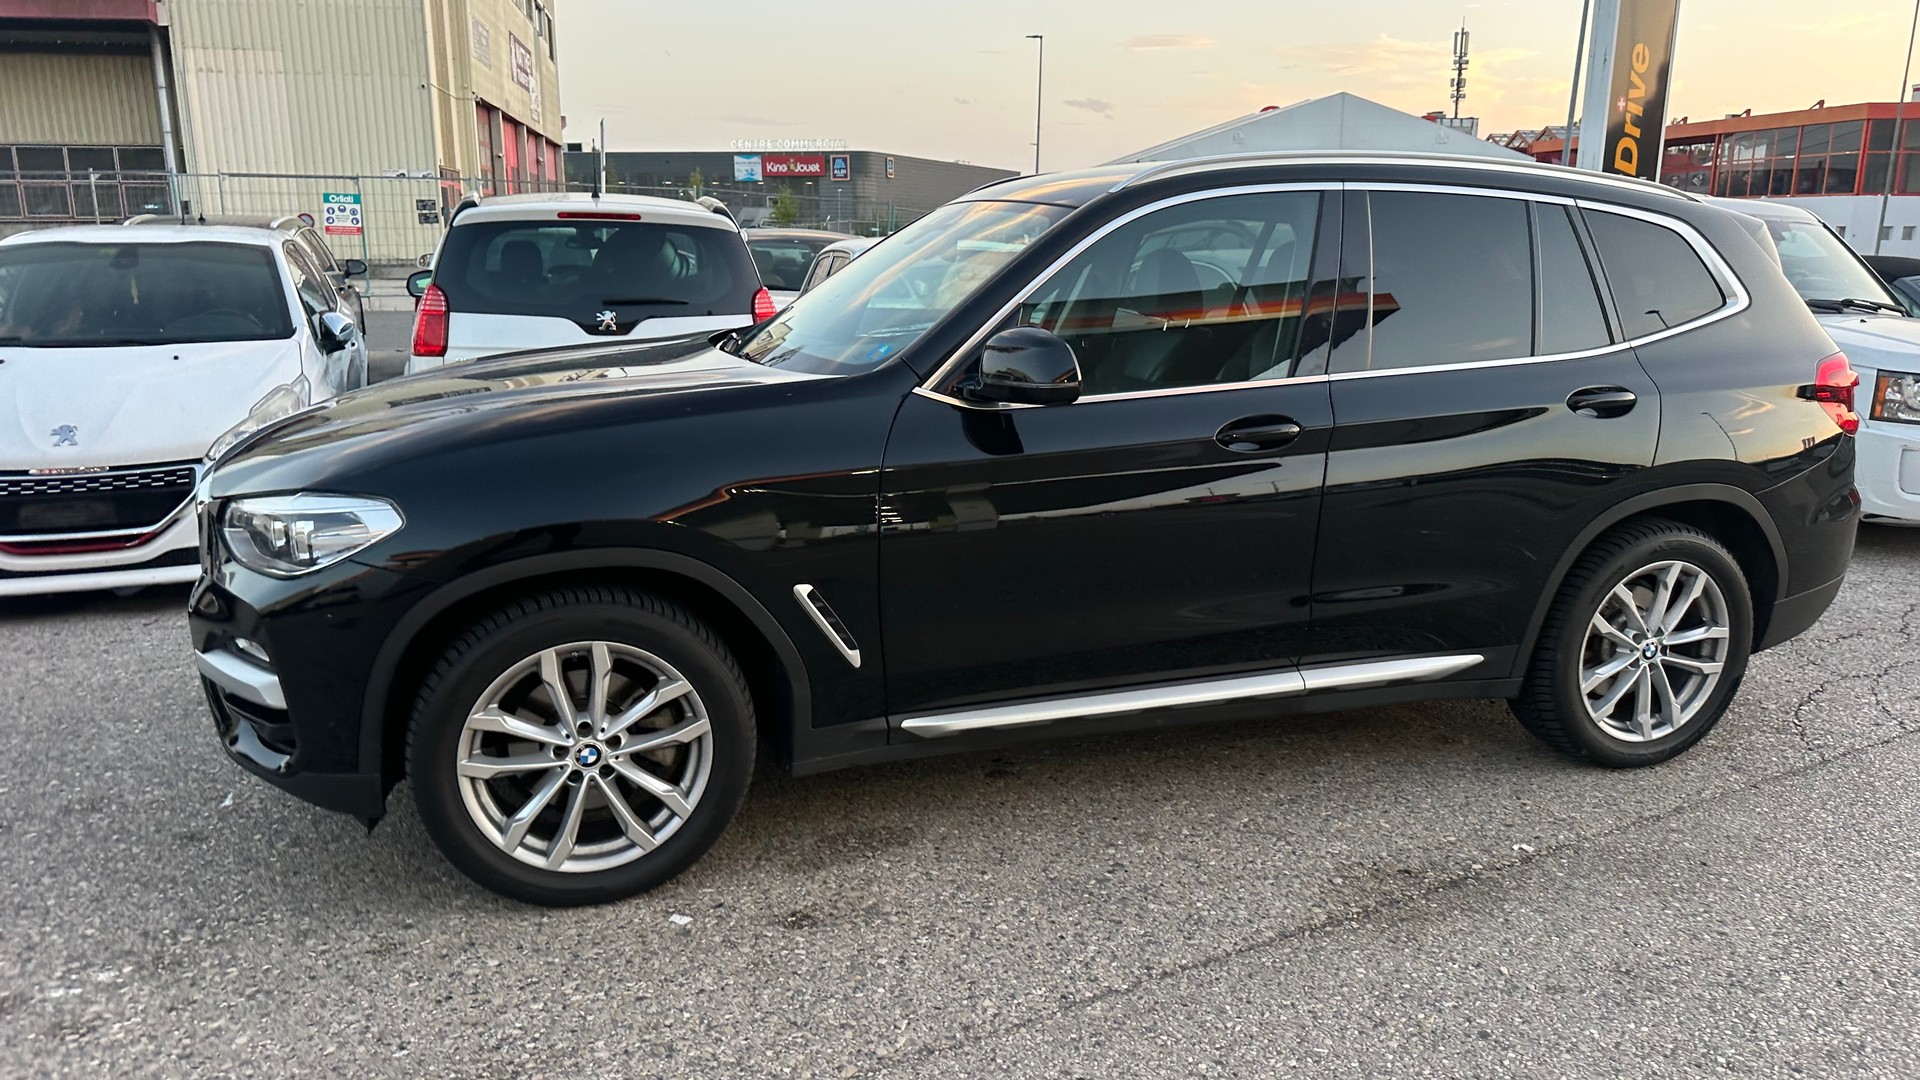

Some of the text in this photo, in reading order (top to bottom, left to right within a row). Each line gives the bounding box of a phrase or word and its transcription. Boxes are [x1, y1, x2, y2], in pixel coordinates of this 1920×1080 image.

[1614, 42, 1650, 176] Drive
[731, 139, 772, 149] CENTRE
[795, 162, 820, 172] Jouet
